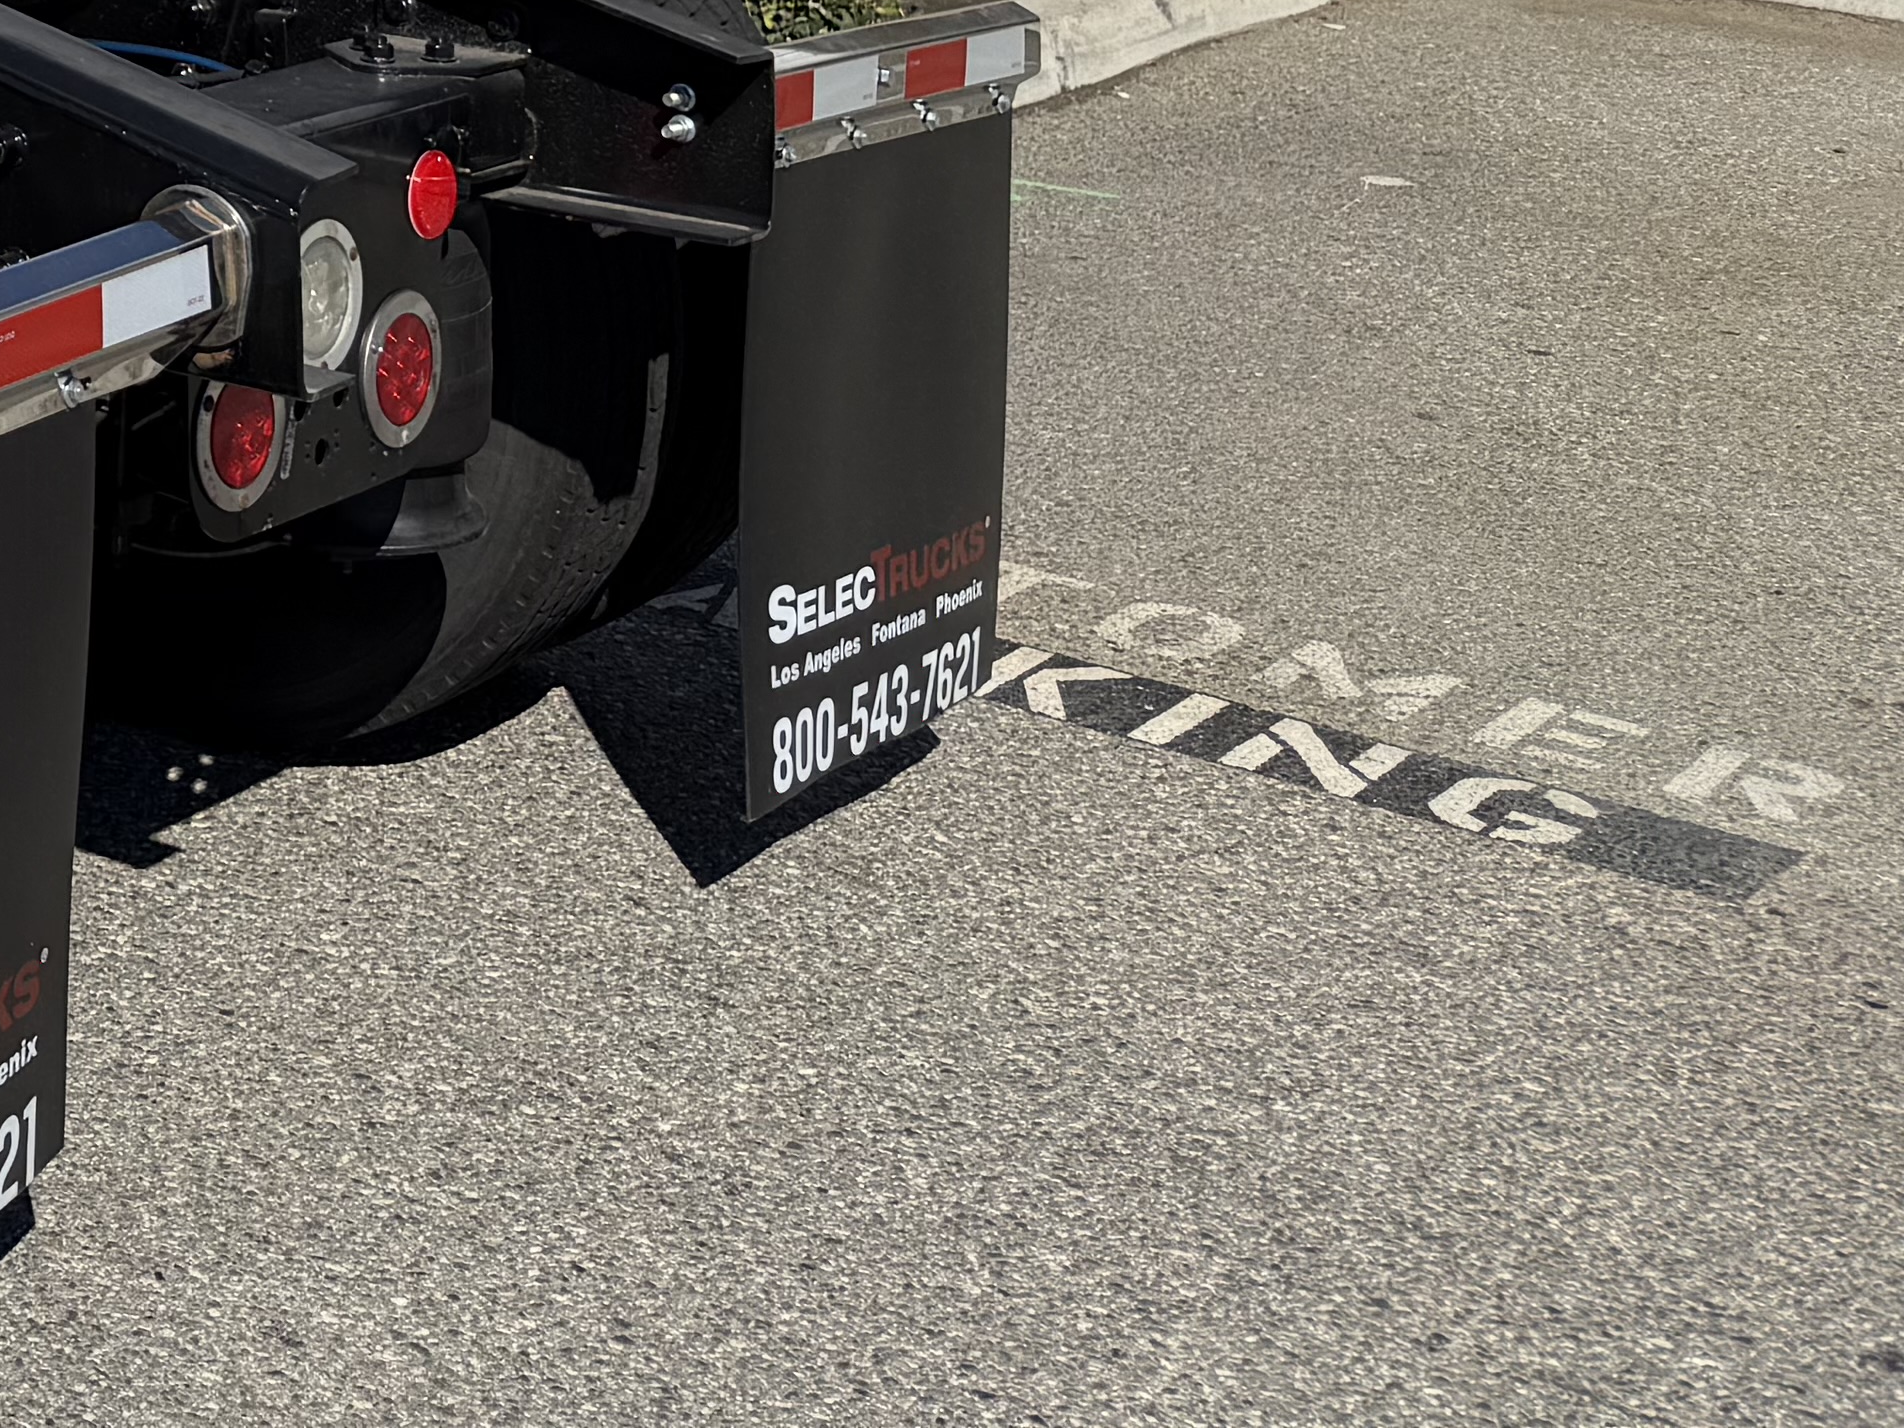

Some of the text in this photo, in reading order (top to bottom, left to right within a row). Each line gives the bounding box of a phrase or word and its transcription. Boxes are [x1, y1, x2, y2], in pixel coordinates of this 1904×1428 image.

[770, 579, 983, 689] Los Angeles Fontana Phoenix
[772, 626, 982, 794] 800-543-7621
